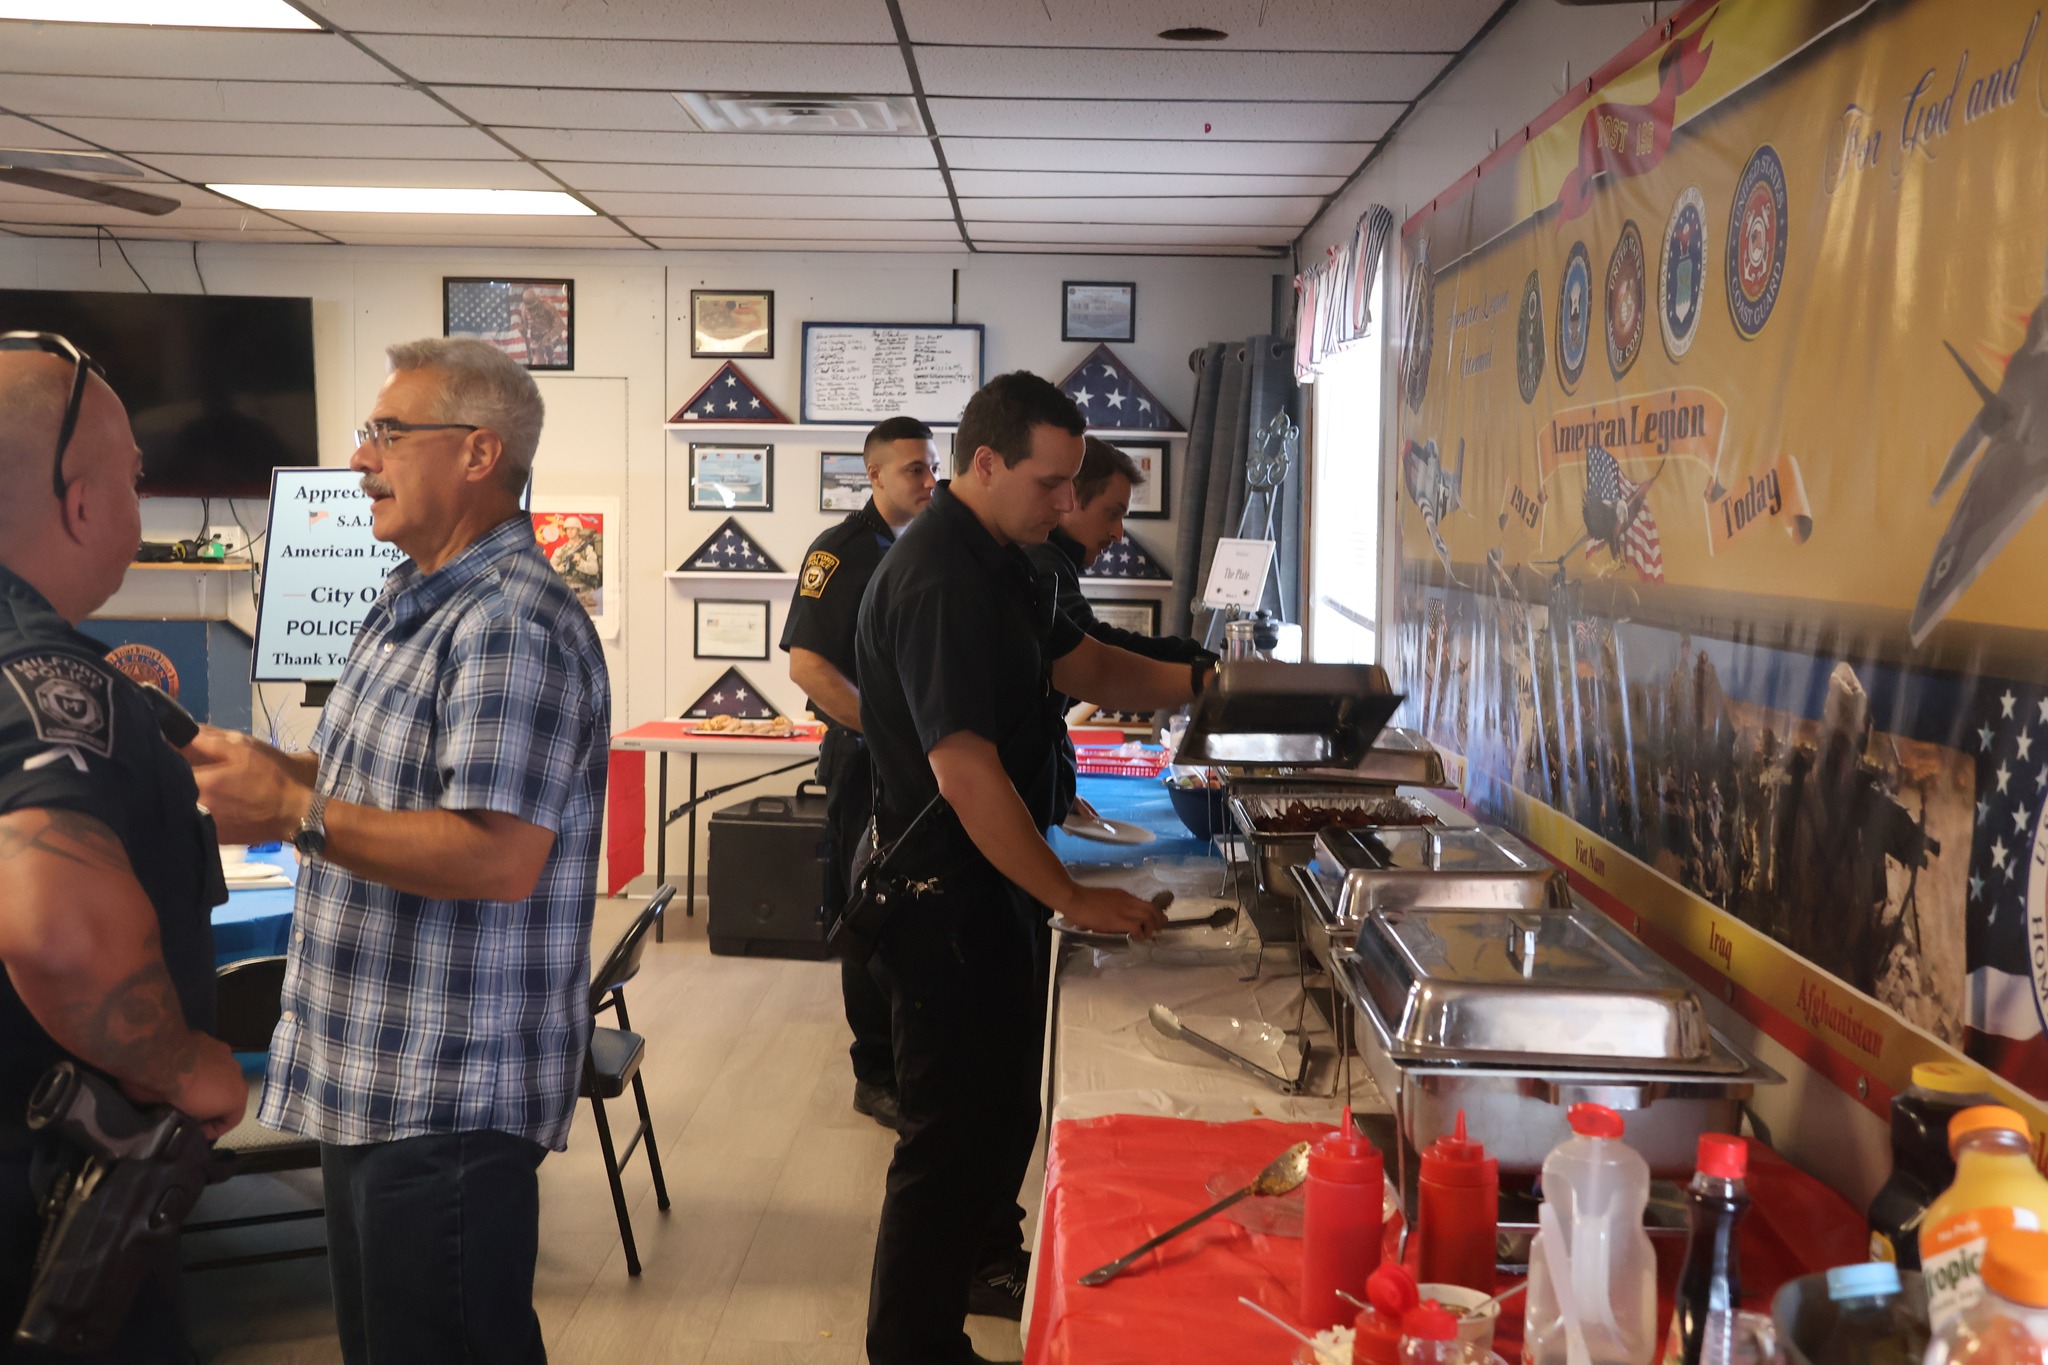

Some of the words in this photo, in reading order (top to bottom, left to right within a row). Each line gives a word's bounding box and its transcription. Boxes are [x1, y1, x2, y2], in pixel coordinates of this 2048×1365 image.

[1824, 103, 1881, 194] For
[1893, 49, 1969, 172] God
[1964, 10, 2041, 125] and
[1597, 115, 1629, 154] POST
[1734, 158, 1760, 228] UNITED
[1759, 154, 1784, 209] STATES
[1731, 276, 1753, 326] COAST
[1753, 260, 1782, 326] GUARD
[1552, 407, 1627, 453] American
[1630, 390, 1705, 454] Legion
[1509, 484, 1539, 529] 1919
[1720, 468, 1783, 539] Today
[281, 544, 364, 558] American
[310, 586, 355, 608] City
[360, 586, 385, 604] O
[286, 620, 362, 637] POLICE
[13, 655, 104, 686] MILFORD
[24, 664, 99, 689] POLICE
[272, 652, 322, 666] Thank
[326, 652, 347, 666] Yo
[1575, 837, 1588, 865] Viet
[1587, 846, 1606, 878] Nam
[1709, 921, 1733, 971] Iraq
[2031, 916, 2048, 1003] HOM
[1796, 976, 1884, 1060] Afghanistan
[1922, 1247, 1979, 1298] ropic
